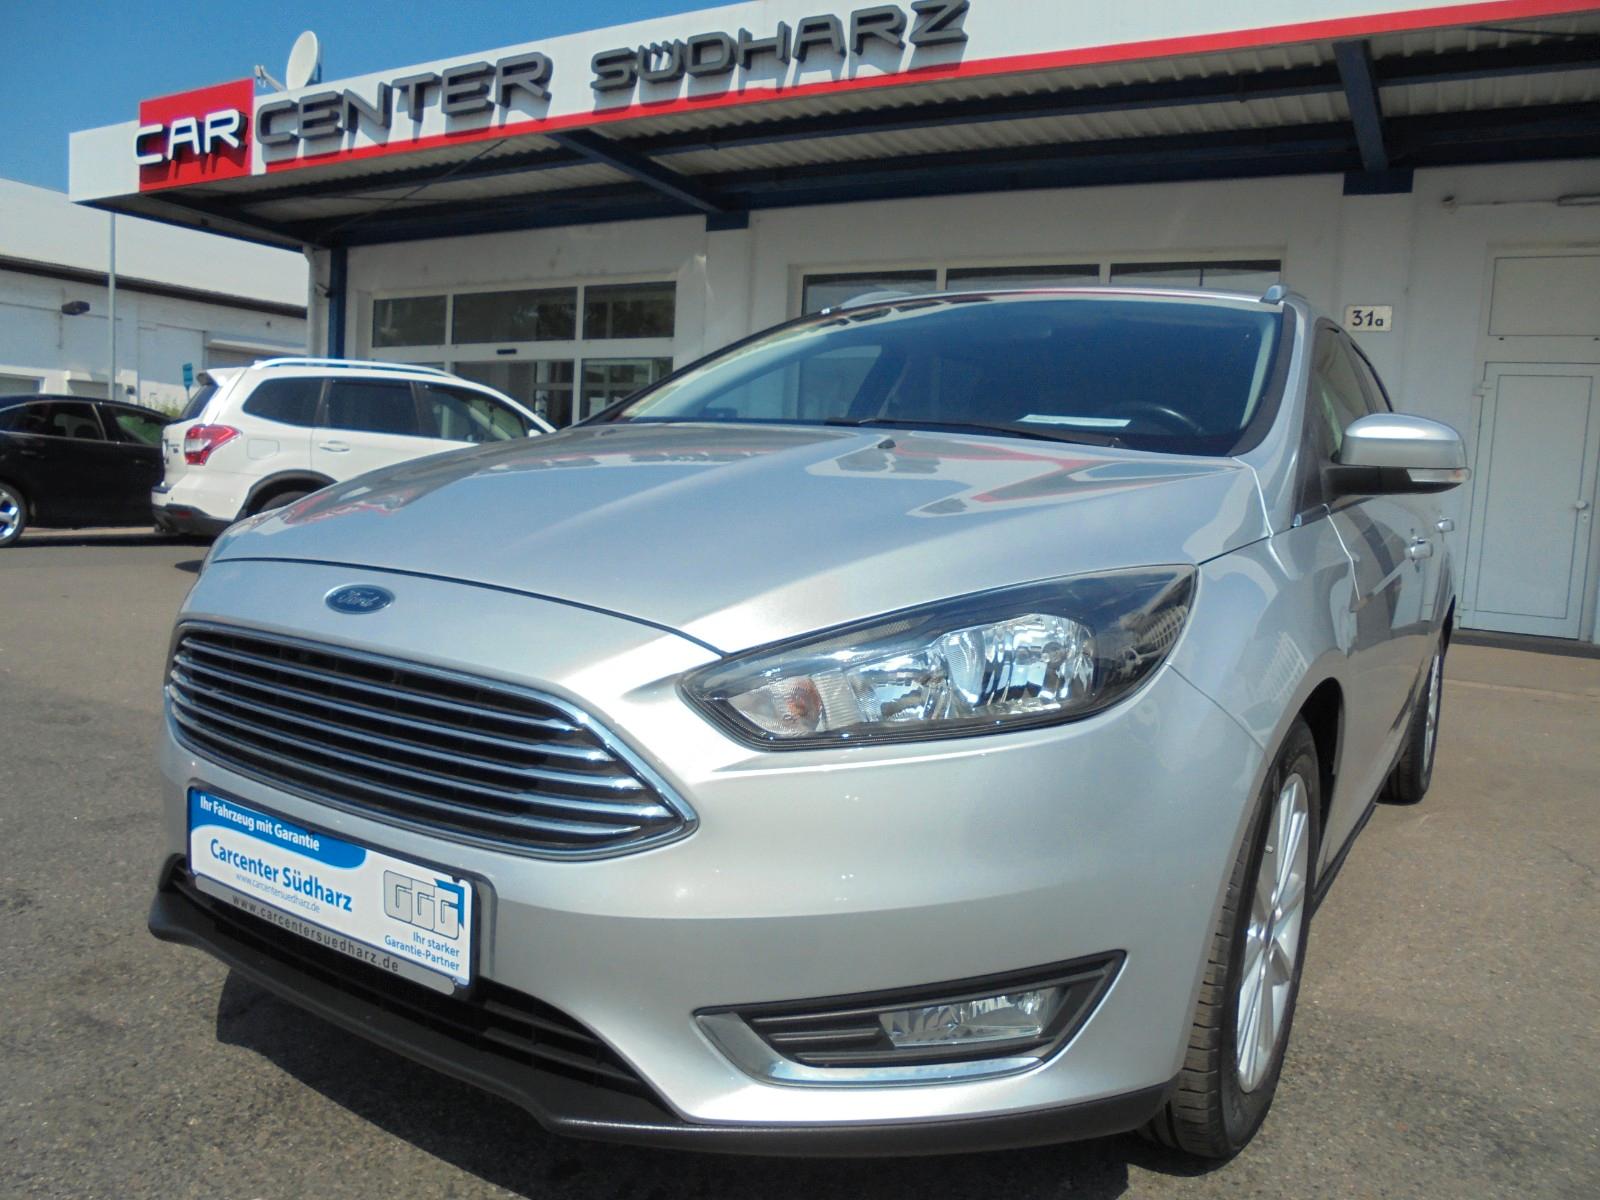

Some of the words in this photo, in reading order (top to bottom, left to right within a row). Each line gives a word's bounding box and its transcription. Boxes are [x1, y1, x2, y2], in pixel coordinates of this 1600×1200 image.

[133, 108, 247, 165] CAR
[255, 51, 553, 146] CENTER
[590, 0, 970, 92] SÜDHARZ
[1352, 309, 1384, 327] 31a
[200, 795, 212, 812] Ihr
[213, 800, 255, 832] Fahrzeug
[256, 819, 273, 835] mit
[274, 823, 320, 851] Garantie
[210, 838, 280, 882] Carcenter
[282, 866, 353, 913] Südharz
[235, 872, 321, 914] www.carcentersuedharz.de
[231, 893, 399, 973] www.carcentersuedharz.de
[384, 934, 460, 971] Garantie-Partner
[412, 931, 425, 944] Ihr
[427, 937, 460, 958] starker
